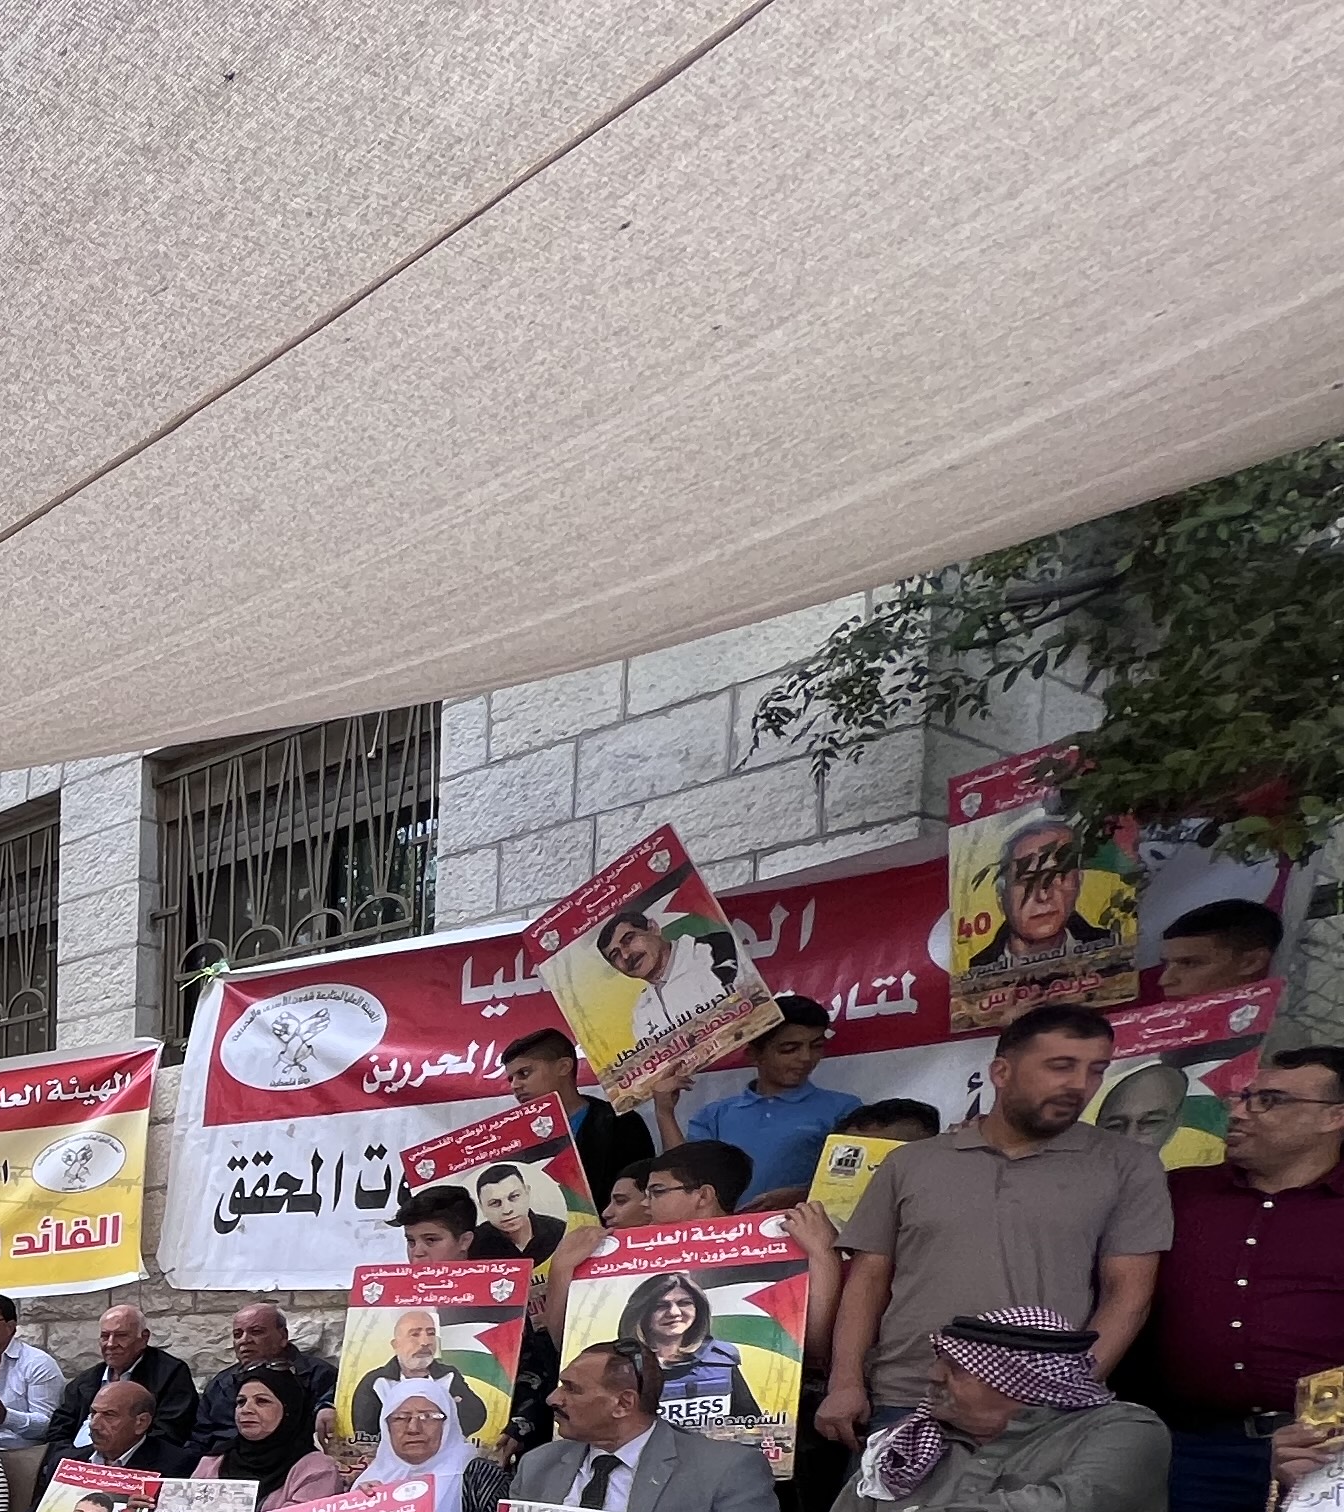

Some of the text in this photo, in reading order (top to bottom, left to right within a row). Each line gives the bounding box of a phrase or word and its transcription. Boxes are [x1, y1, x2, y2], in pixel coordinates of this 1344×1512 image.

[47, 1070, 132, 1103] الهيئة
[213, 1149, 342, 1236] المحقق
[11, 1213, 122, 1256] القائد
[626, 1223, 752, 1251] الهيئة العليا
[361, 1264, 521, 1281] حركة التحرير الوطني الفلسطيني
[590, 1243, 787, 1275] لمتابعة شؤون الأسرى والمحررين
[340, 1491, 387, 1512] الهيئة
